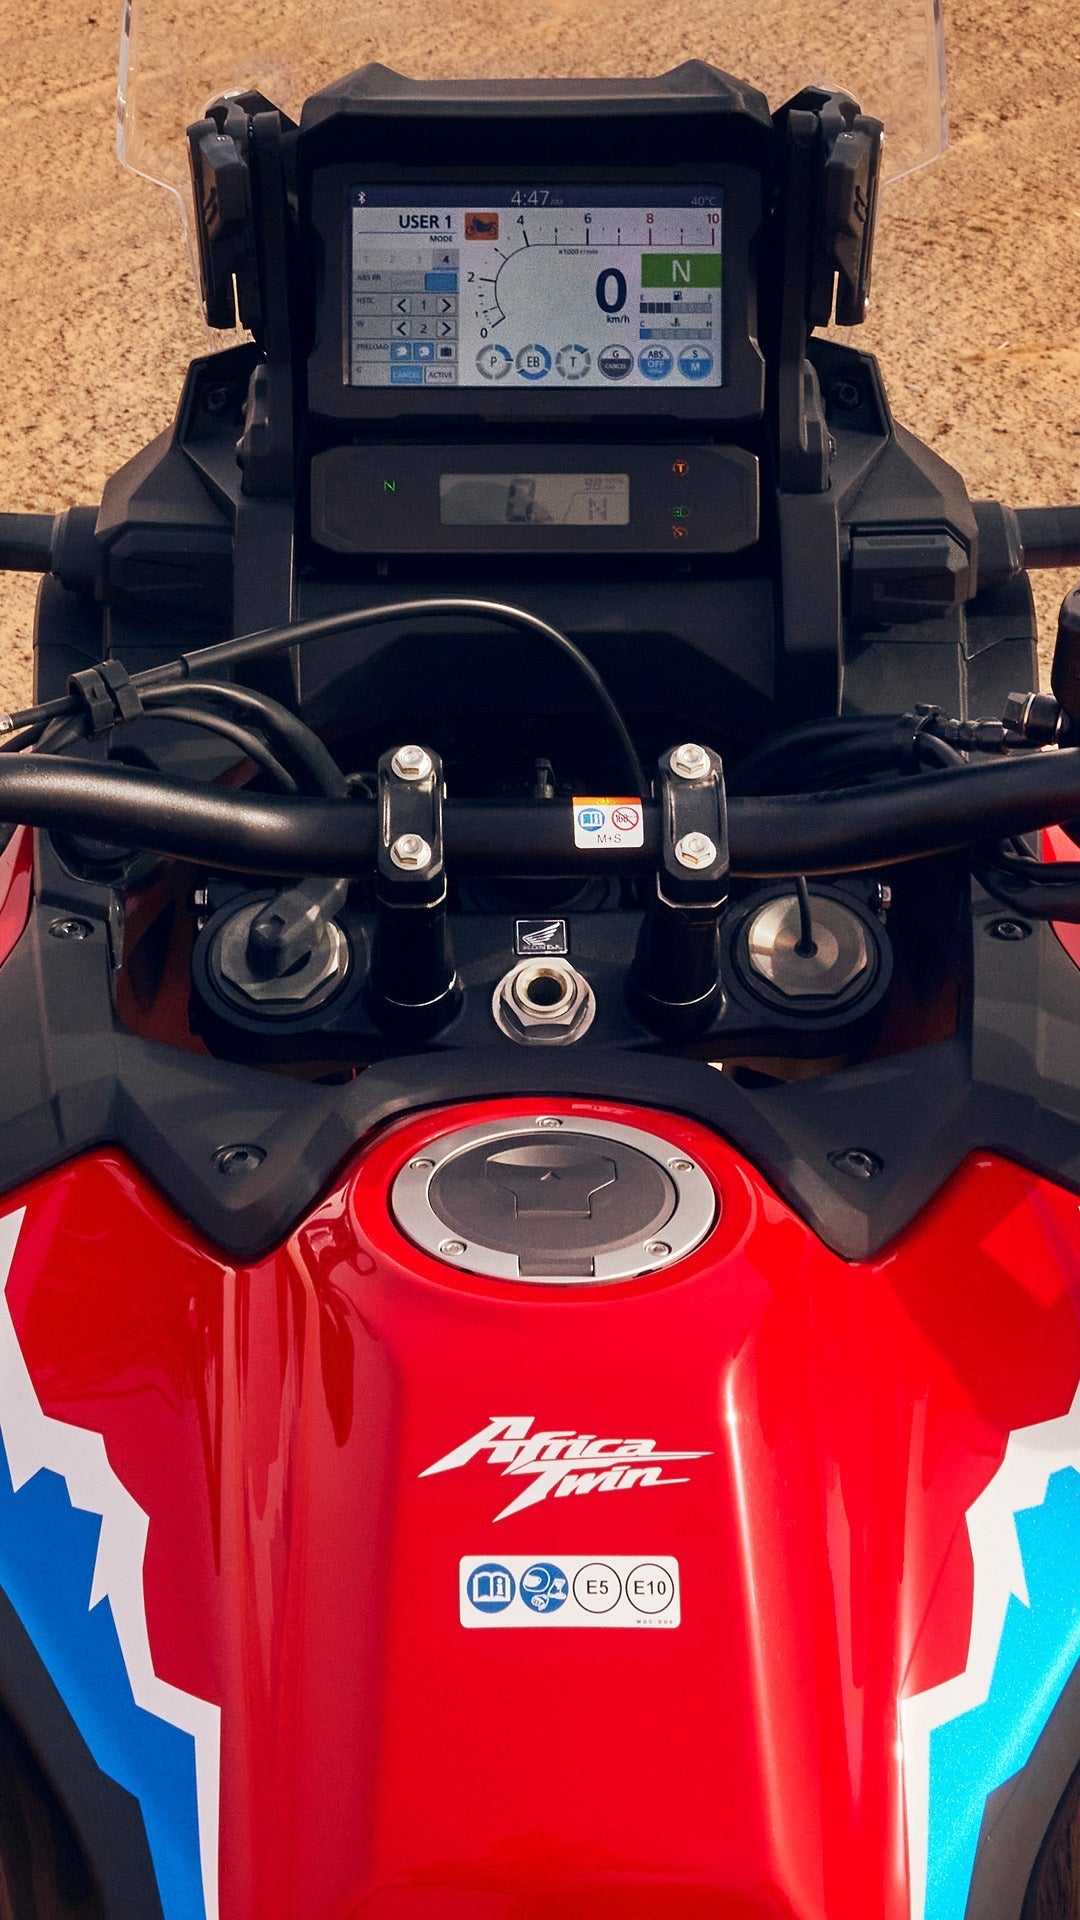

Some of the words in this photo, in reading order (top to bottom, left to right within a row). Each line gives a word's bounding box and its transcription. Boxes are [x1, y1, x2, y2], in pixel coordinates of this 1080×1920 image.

[511, 190, 549, 206] 4:47
[691, 196, 716, 206] 40°C
[399, 215, 440, 229] USER
[444, 215, 452, 228] 1
[516, 215, 524, 225] 4
[584, 213, 592, 224] 6
[646, 213, 654, 224] 8
[707, 213, 720, 224] 10
[429, 235, 453, 243] MODE
[442, 255, 450, 263] 4
[672, 260, 692, 282] N
[467, 272, 475, 282] 2
[595, 268, 627, 314] 0
[421, 301, 426, 311] 1
[606, 315, 630, 324] km/h
[420, 325, 427, 334] 2
[480, 328, 488, 338] 0
[612, 350, 619, 358] G
[647, 350, 664, 358] ABS
[693, 350, 698, 358] S
[490, 356, 497, 367] P
[527, 356, 540, 367] EB
[570, 356, 577, 367] T
[647, 360, 664, 368] OFF
[690, 362, 700, 371] M
[428, 371, 453, 379] ACTIVE
[384, 480, 396, 492] N
[588, 497, 607, 521] N
[597, 832, 622, 843] M+S
[418, 1416, 715, 1479] Africa
[492, 1456, 690, 1523] Twin
[586, 1580, 609, 1595] E5
[633, 1580, 666, 1595] E10
